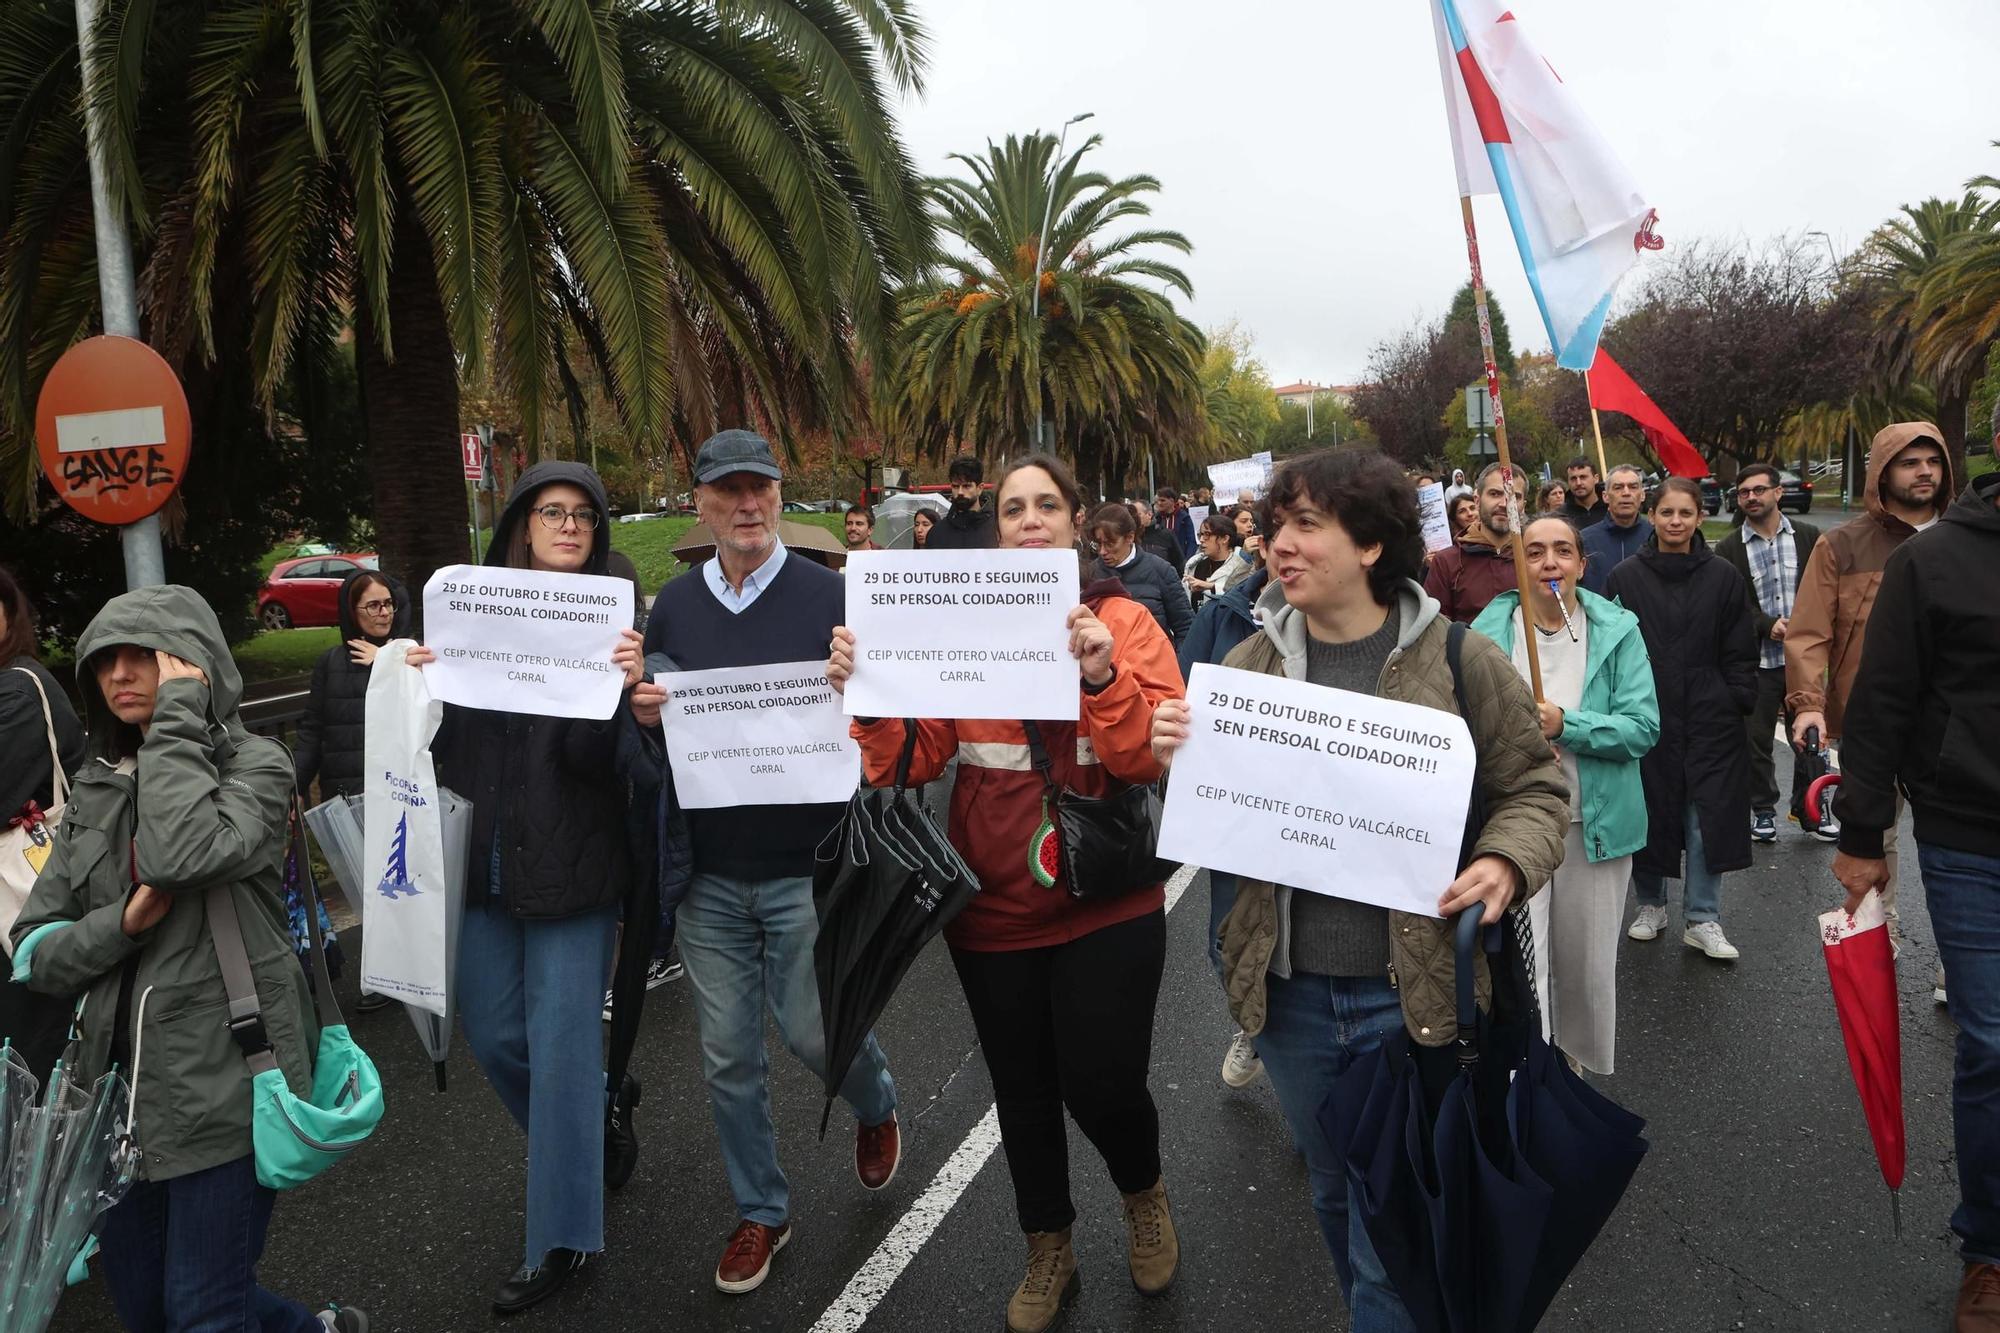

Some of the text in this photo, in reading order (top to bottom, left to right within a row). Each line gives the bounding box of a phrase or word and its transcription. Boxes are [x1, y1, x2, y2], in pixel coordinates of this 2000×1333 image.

[864, 572, 1059, 584] 29 DE OUTUBRO E SEGUIMOS
[442, 582, 617, 607] 29 DE OUTUBRO E SEGUIMOS
[871, 592, 1050, 605] SEN PERSOAL COIDADOR!!!
[449, 600, 609, 624] SEN PERSOAL COIDADOR!!!
[443, 648, 610, 673] CEIP VICENTE OTERO VALCÁRCEL
[868, 648, 1057, 662] CEIP VICENTE OTERO VALCÁRCEL
[507, 671, 546, 684] CARRAL
[673, 677, 832, 698] 29 DE OUTUBRO E SEGUIMO
[940, 671, 986, 682] CARRAL
[683, 692, 832, 715] SEN PERSOAL COIDADOR!!!
[1208, 692, 1451, 751] 29 DE OUTUBRO E SEGUIMOS
[687, 742, 843, 762] CEIP VICENTE OTERO VALCÁRCEL
[1213, 718, 1438, 774] SEN PERSOAL COIDADOR!!!
[750, 764, 785, 774] CARRAL
[1196, 785, 1431, 844] CEIP VICENTE OTERO VALCÁRCEL
[1281, 827, 1337, 850] CARRAL
